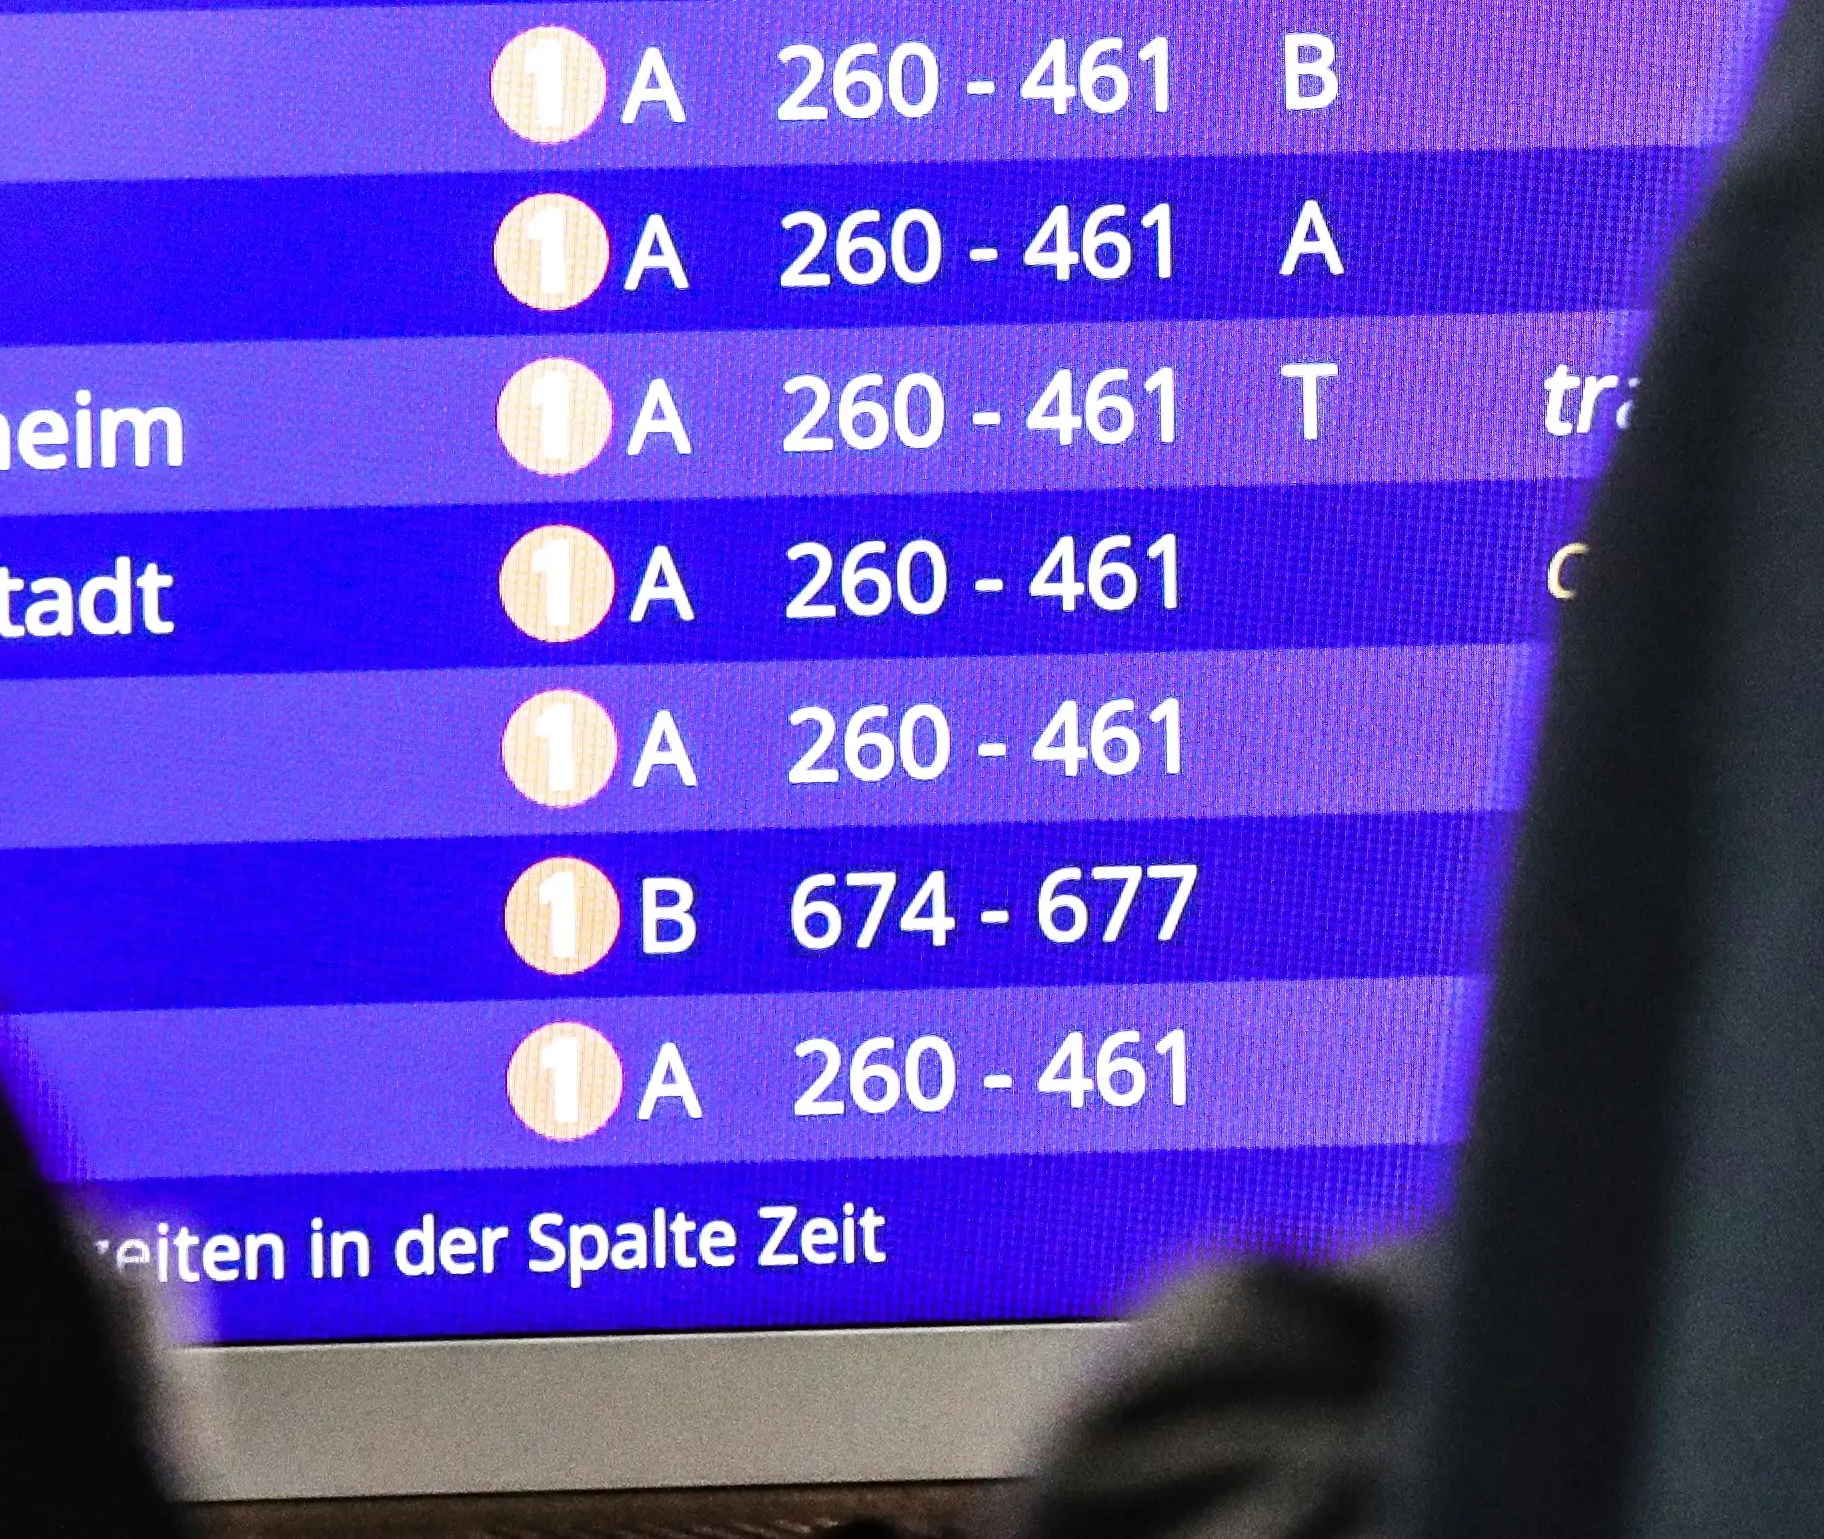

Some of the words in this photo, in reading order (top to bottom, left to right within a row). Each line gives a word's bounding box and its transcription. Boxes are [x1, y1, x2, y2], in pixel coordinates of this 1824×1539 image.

[622, 47, 685, 123] A
[777, 41, 939, 120] 260
[1021, 37, 1170, 114] 461
[1283, 33, 1339, 110] B
[624, 214, 688, 291] A
[780, 209, 942, 288] 260
[1023, 203, 1173, 281] 461
[1280, 200, 1344, 276] A
[627, 378, 691, 455] A
[783, 373, 944, 452] 260
[1027, 367, 1176, 445] 461
[1281, 362, 1338, 440] T
[631, 545, 694, 622] A
[786, 539, 947, 619] 260
[1029, 534, 1177, 611] 461
[633, 710, 696, 786] A
[789, 704, 950, 783] 260
[1033, 698, 1181, 775] 461
[640, 877, 695, 953] B
[792, 871, 954, 949] 674
[1037, 865, 1198, 942] 677
[639, 1043, 701, 1119] A
[795, 1036, 955, 1115] 260
[1038, 1029, 1188, 1107] 461
[311, 1216, 370, 1278] in
[396, 1215, 508, 1276] der
[530, 1204, 737, 1288] Spalte
[758, 1201, 885, 1267] Zeit
